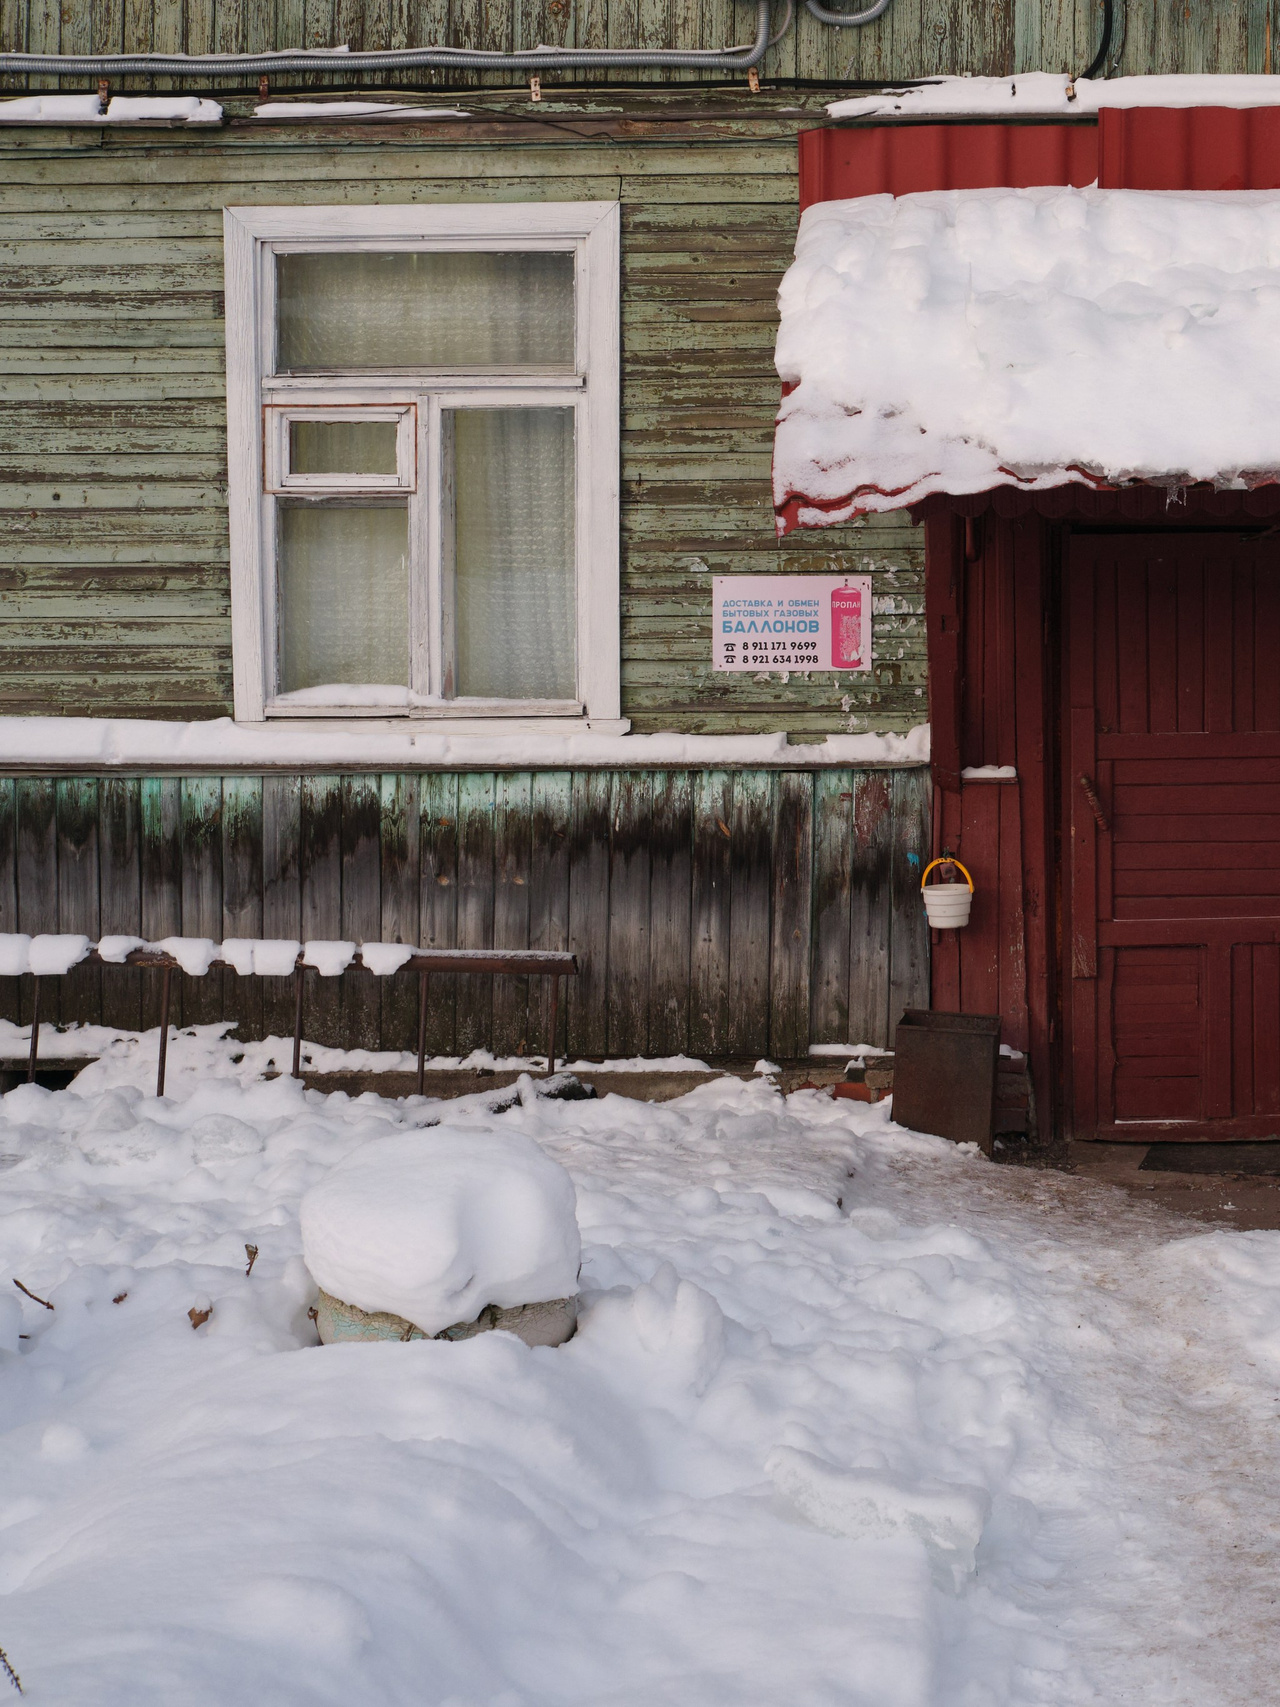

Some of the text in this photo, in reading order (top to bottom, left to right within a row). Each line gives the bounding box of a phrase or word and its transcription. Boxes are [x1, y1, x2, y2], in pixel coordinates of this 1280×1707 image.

[722, 599, 820, 608] ДОСТАВКА И ОБМЕН
[832, 601, 861, 609] ПРОПАН
[722, 609, 819, 618] БЫТОВЫХ ГАЗОВЫХ
[722, 620, 820, 634] БАЛЛОНОВ
[742, 641, 817, 651] 8 911 171 9699
[742, 654, 819, 664] 8 921 634 1998
